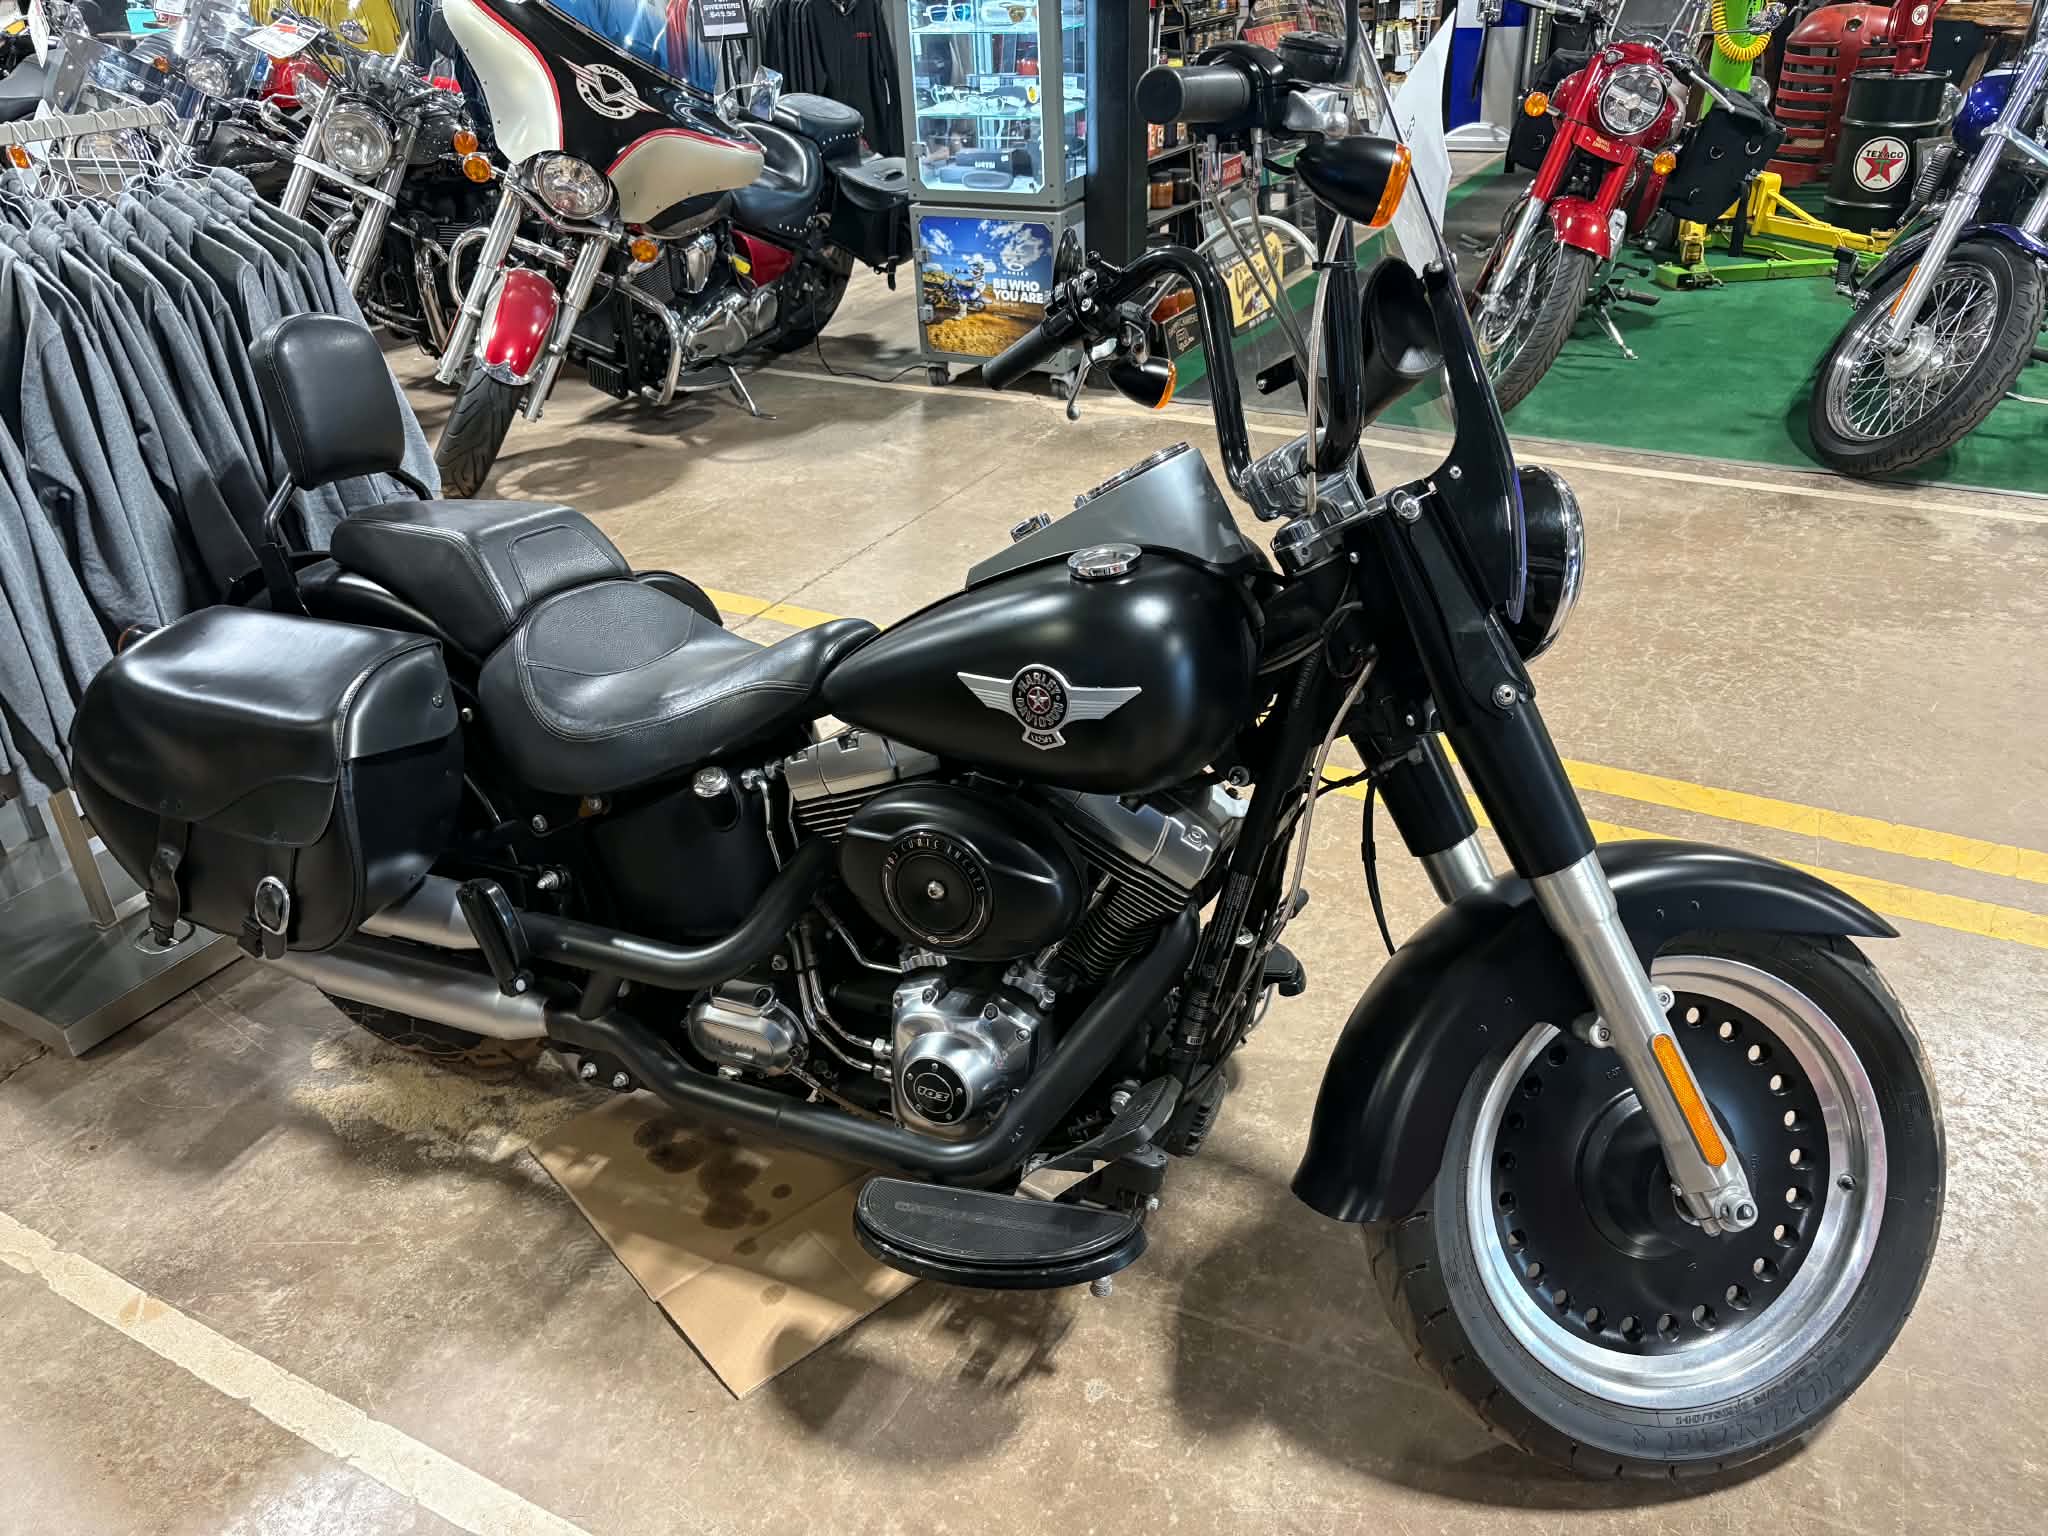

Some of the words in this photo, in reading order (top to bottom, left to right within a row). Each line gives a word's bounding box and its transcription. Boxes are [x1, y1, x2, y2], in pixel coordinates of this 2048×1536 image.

[1865, 150, 1904, 159] TEXACO
[993, 278, 1007, 290] BE
[1008, 279, 1040, 292] WHO
[993, 290, 1019, 303] YOU
[1020, 291, 1044, 304] ARE
[1018, 672, 1062, 696] HARLEY
[1015, 697, 1064, 728] DAVIDSON
[901, 838, 939, 852] CUBIC
[947, 844, 985, 893] INCHES
